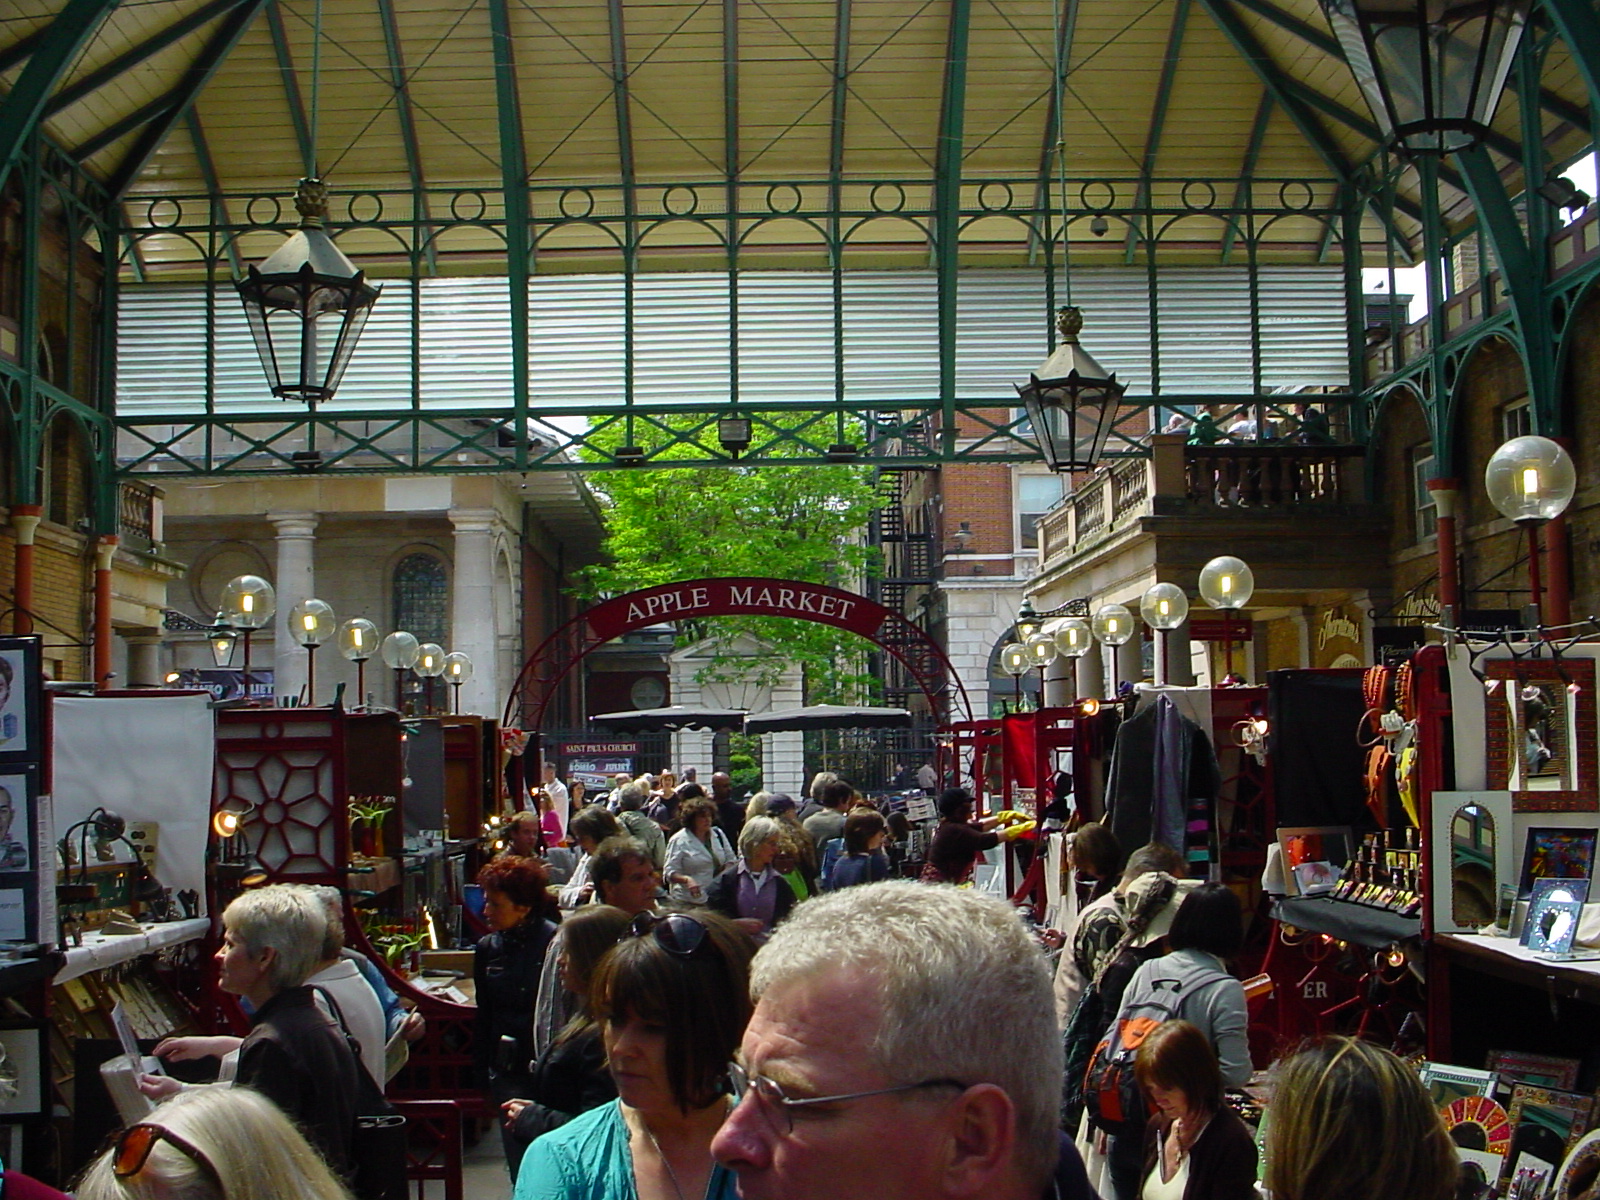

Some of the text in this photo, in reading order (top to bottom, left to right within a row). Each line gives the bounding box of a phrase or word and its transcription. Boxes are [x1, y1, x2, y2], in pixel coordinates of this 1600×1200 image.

[625, 585, 856, 623] APPLE MARKET
[566, 744, 586, 752] SAINT
[607, 743, 636, 752] CHURCH
